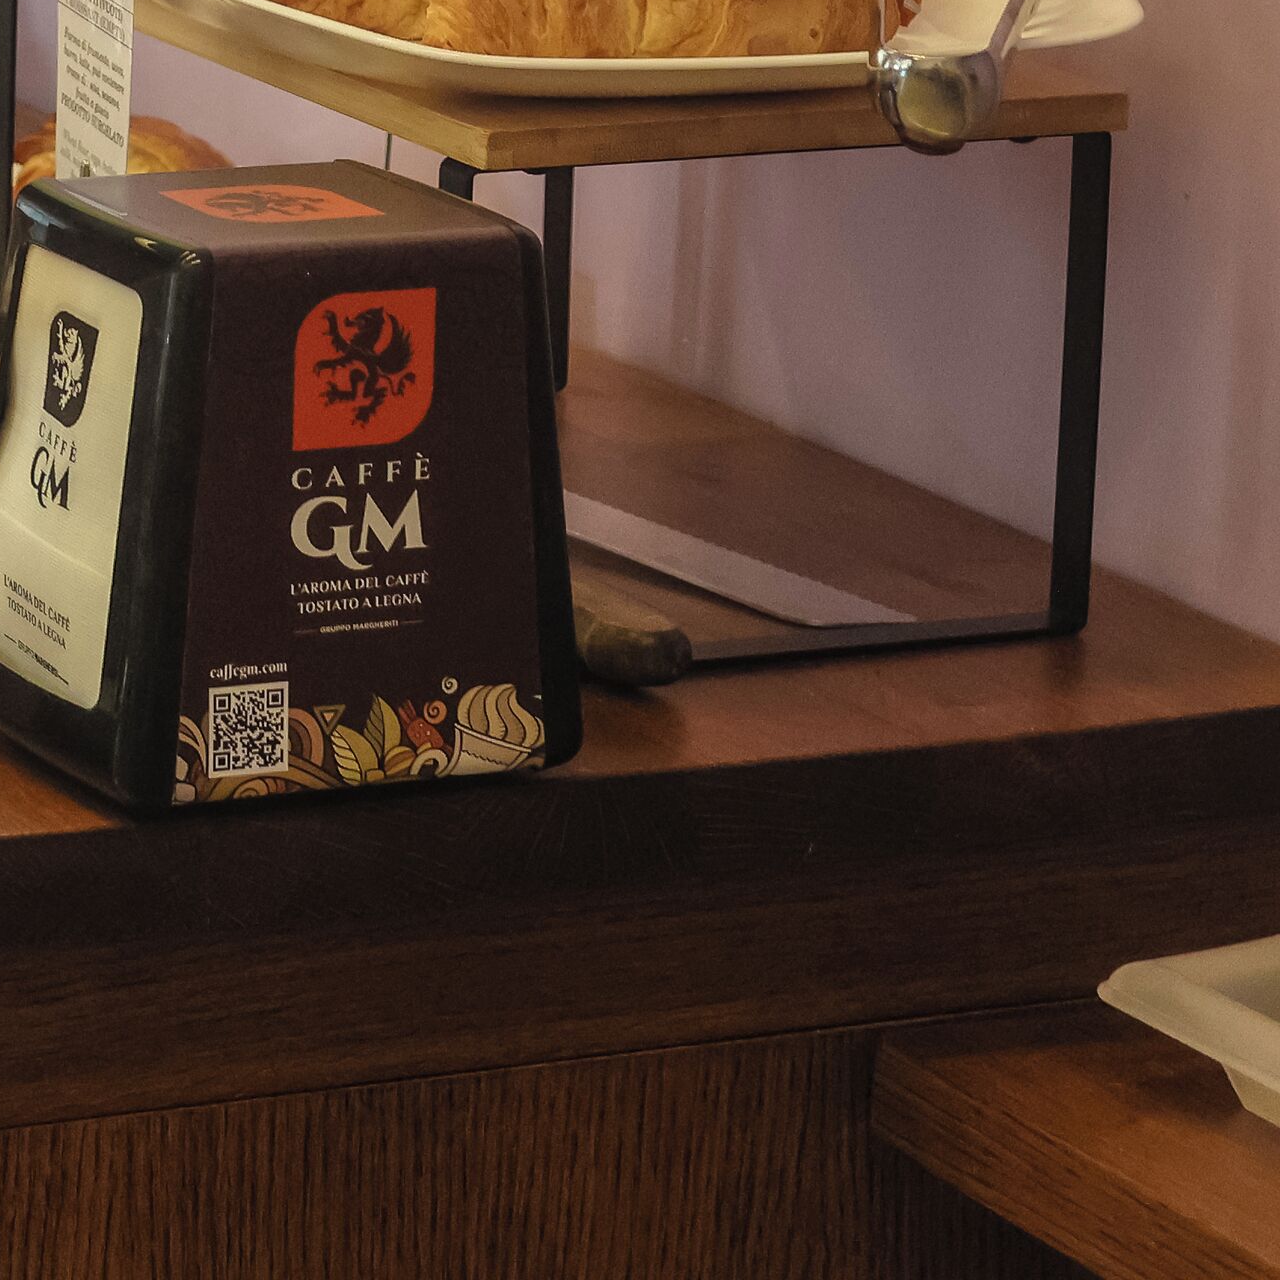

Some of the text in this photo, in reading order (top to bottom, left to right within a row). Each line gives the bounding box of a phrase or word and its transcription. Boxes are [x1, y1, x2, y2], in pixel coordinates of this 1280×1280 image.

[38, 422, 77, 463] CAFFÈ
[30, 446, 70, 511] GM
[291, 452, 430, 490] CAFFÈ
[290, 489, 429, 570] GM
[290, 569, 429, 596] L'AROMA DEL CAFFÈ
[3, 574, 71, 632] L'AROMA DEL CAFFÈ
[297, 592, 422, 614] TOSTATO A LEGNA
[7, 596, 67, 650] TOSTATO A LEGNA
[320, 623, 351, 634] GRUPPO
[209, 662, 288, 680] caffegm.com
